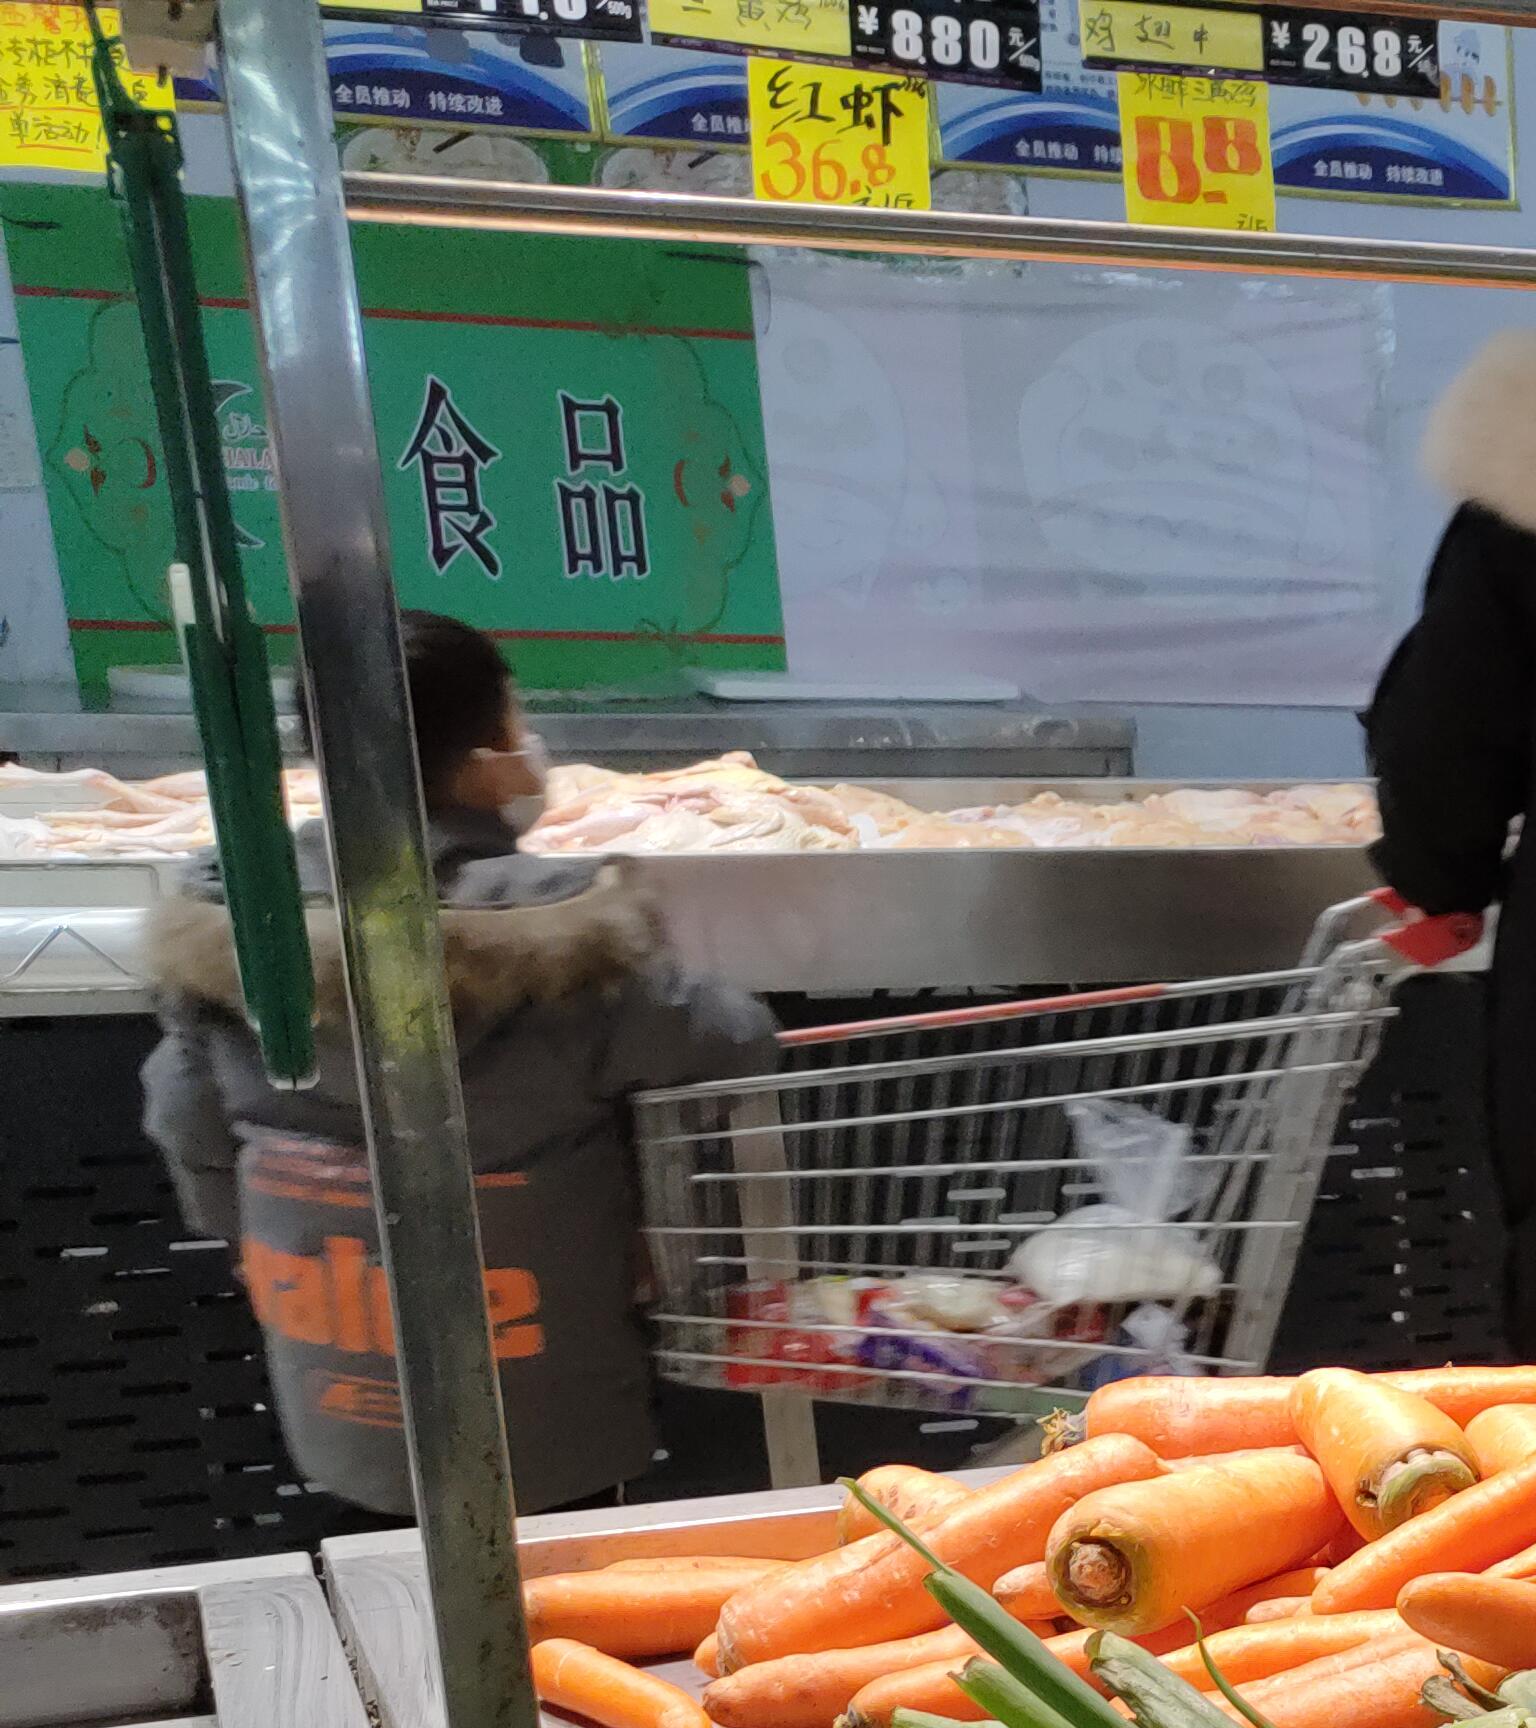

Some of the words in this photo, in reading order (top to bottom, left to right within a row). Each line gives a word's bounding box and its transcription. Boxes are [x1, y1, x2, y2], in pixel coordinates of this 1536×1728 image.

[335, 83, 411, 109] 全员推动
[429, 90, 504, 117] 持续改进
